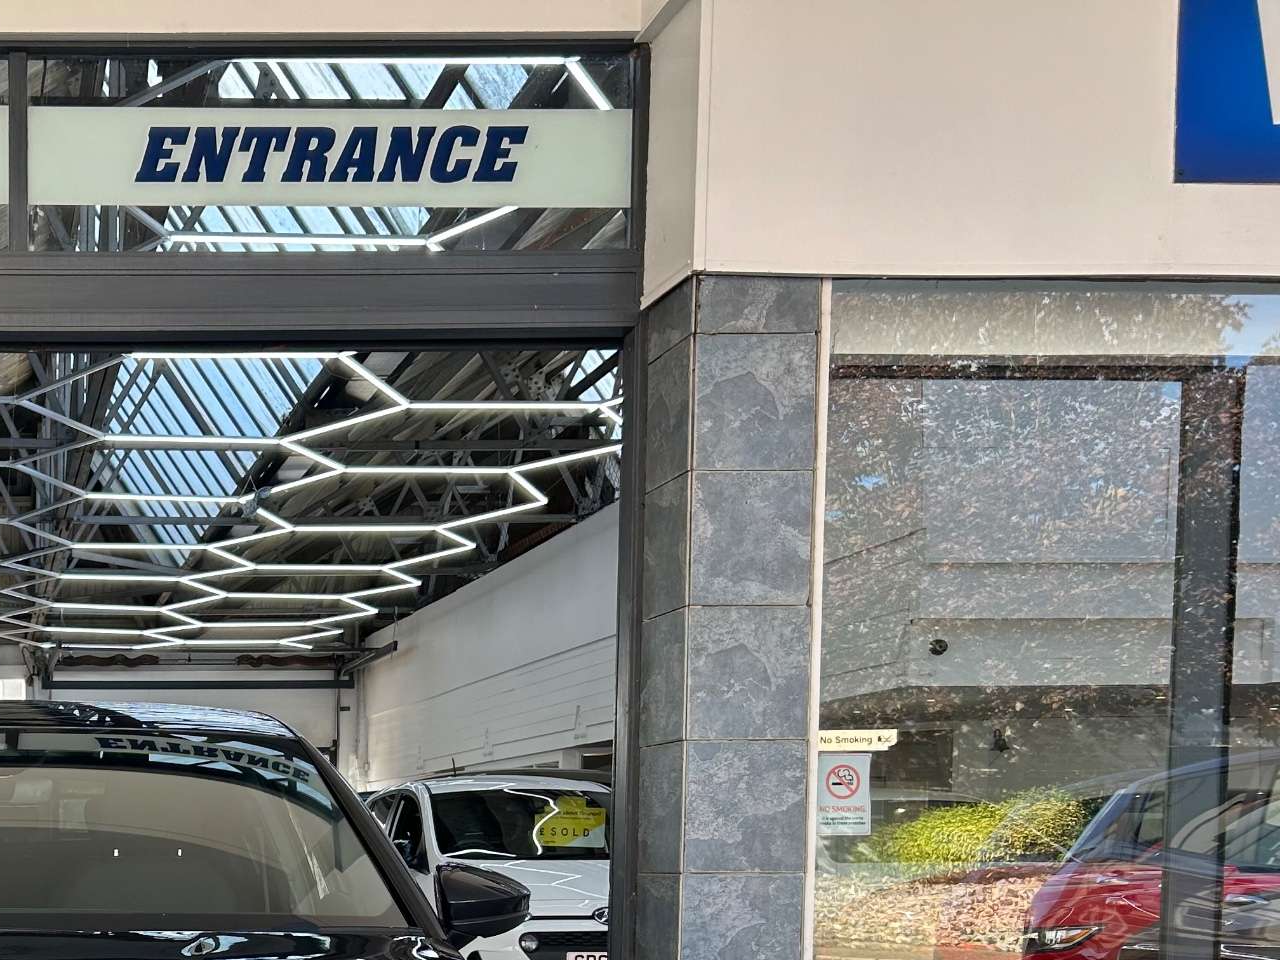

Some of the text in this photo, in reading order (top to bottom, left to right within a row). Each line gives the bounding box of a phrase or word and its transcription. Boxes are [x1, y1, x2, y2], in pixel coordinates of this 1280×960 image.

[135, 125, 529, 183] ENTRANCE
[820, 736, 872, 746] No Smoking
[550, 827, 590, 837] SOLD
